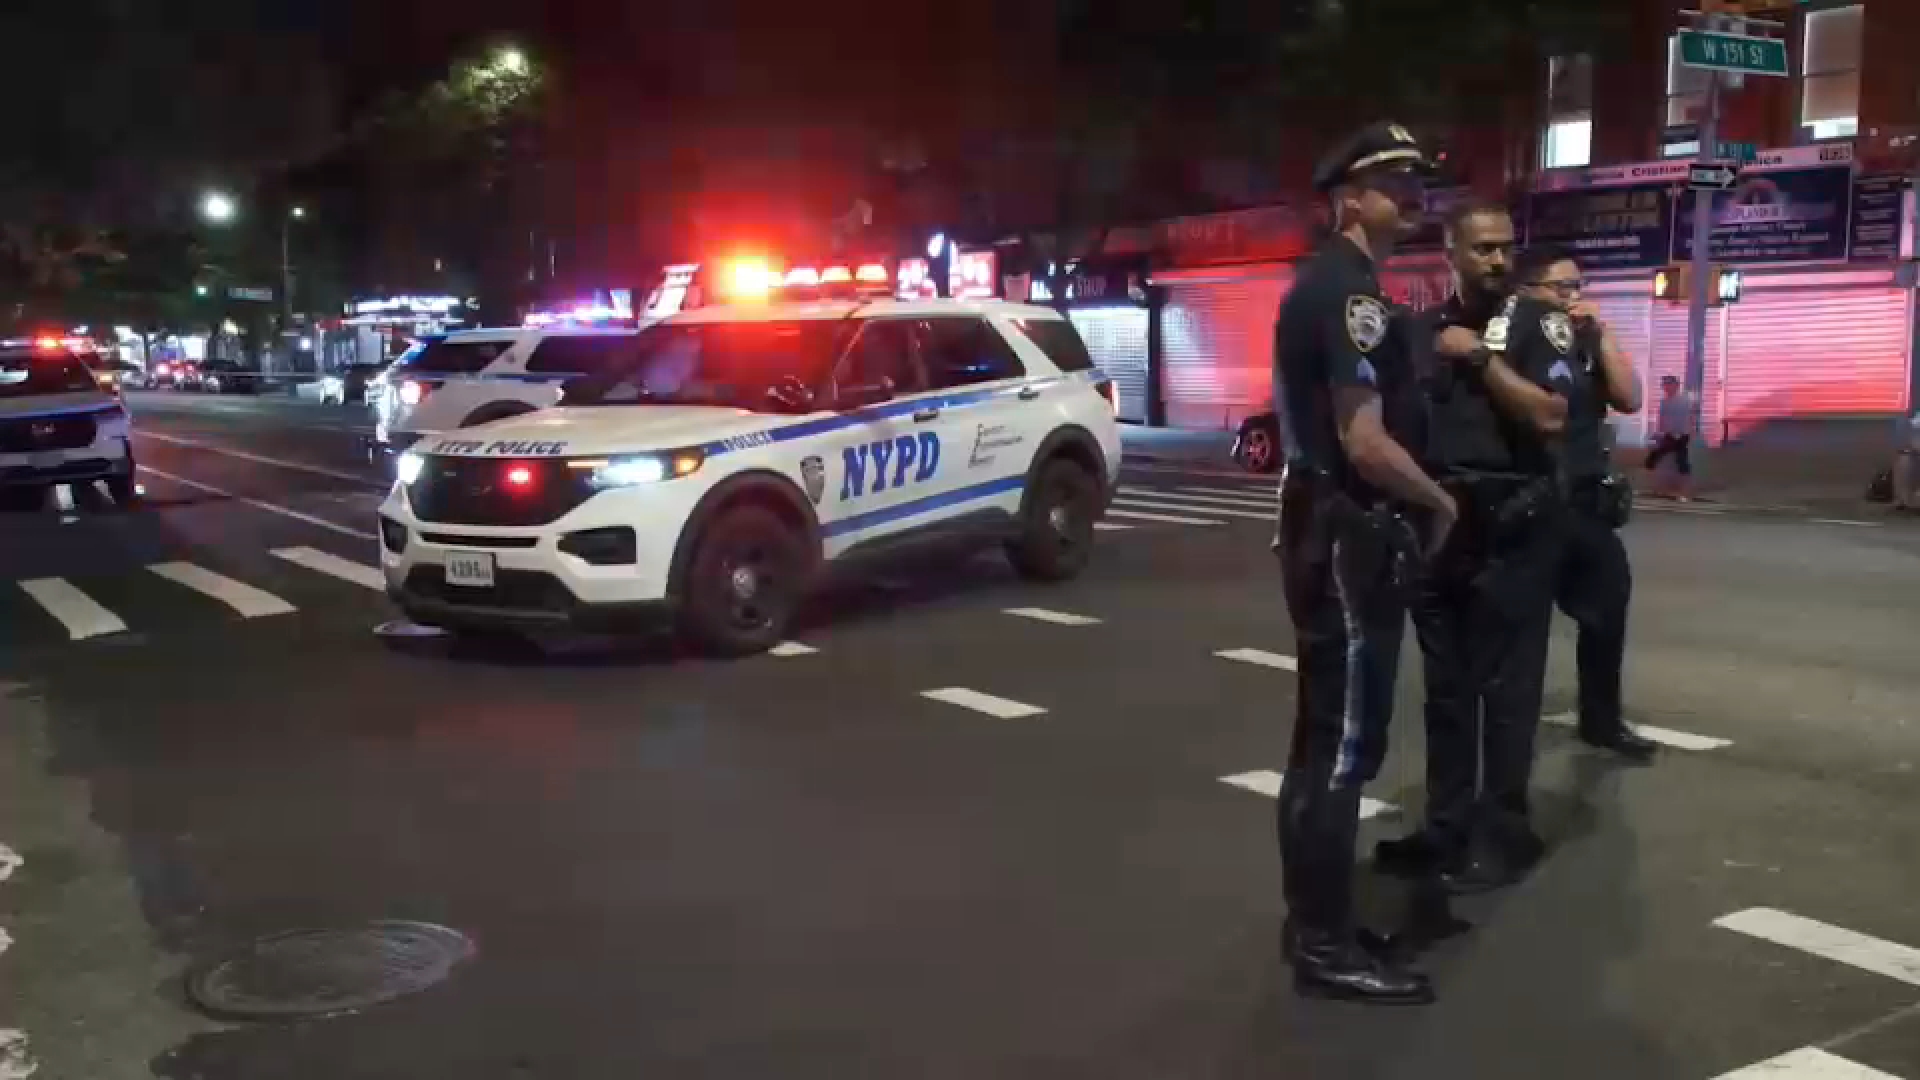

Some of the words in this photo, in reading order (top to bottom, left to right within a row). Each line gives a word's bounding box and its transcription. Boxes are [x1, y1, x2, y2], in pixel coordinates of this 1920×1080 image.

[1702, 38, 1716, 61] W
[1722, 40, 1745, 65] 151
[485, 440, 569, 455] POLICE
[722, 430, 773, 452] POLICE
[840, 431, 942, 501] NYPD
